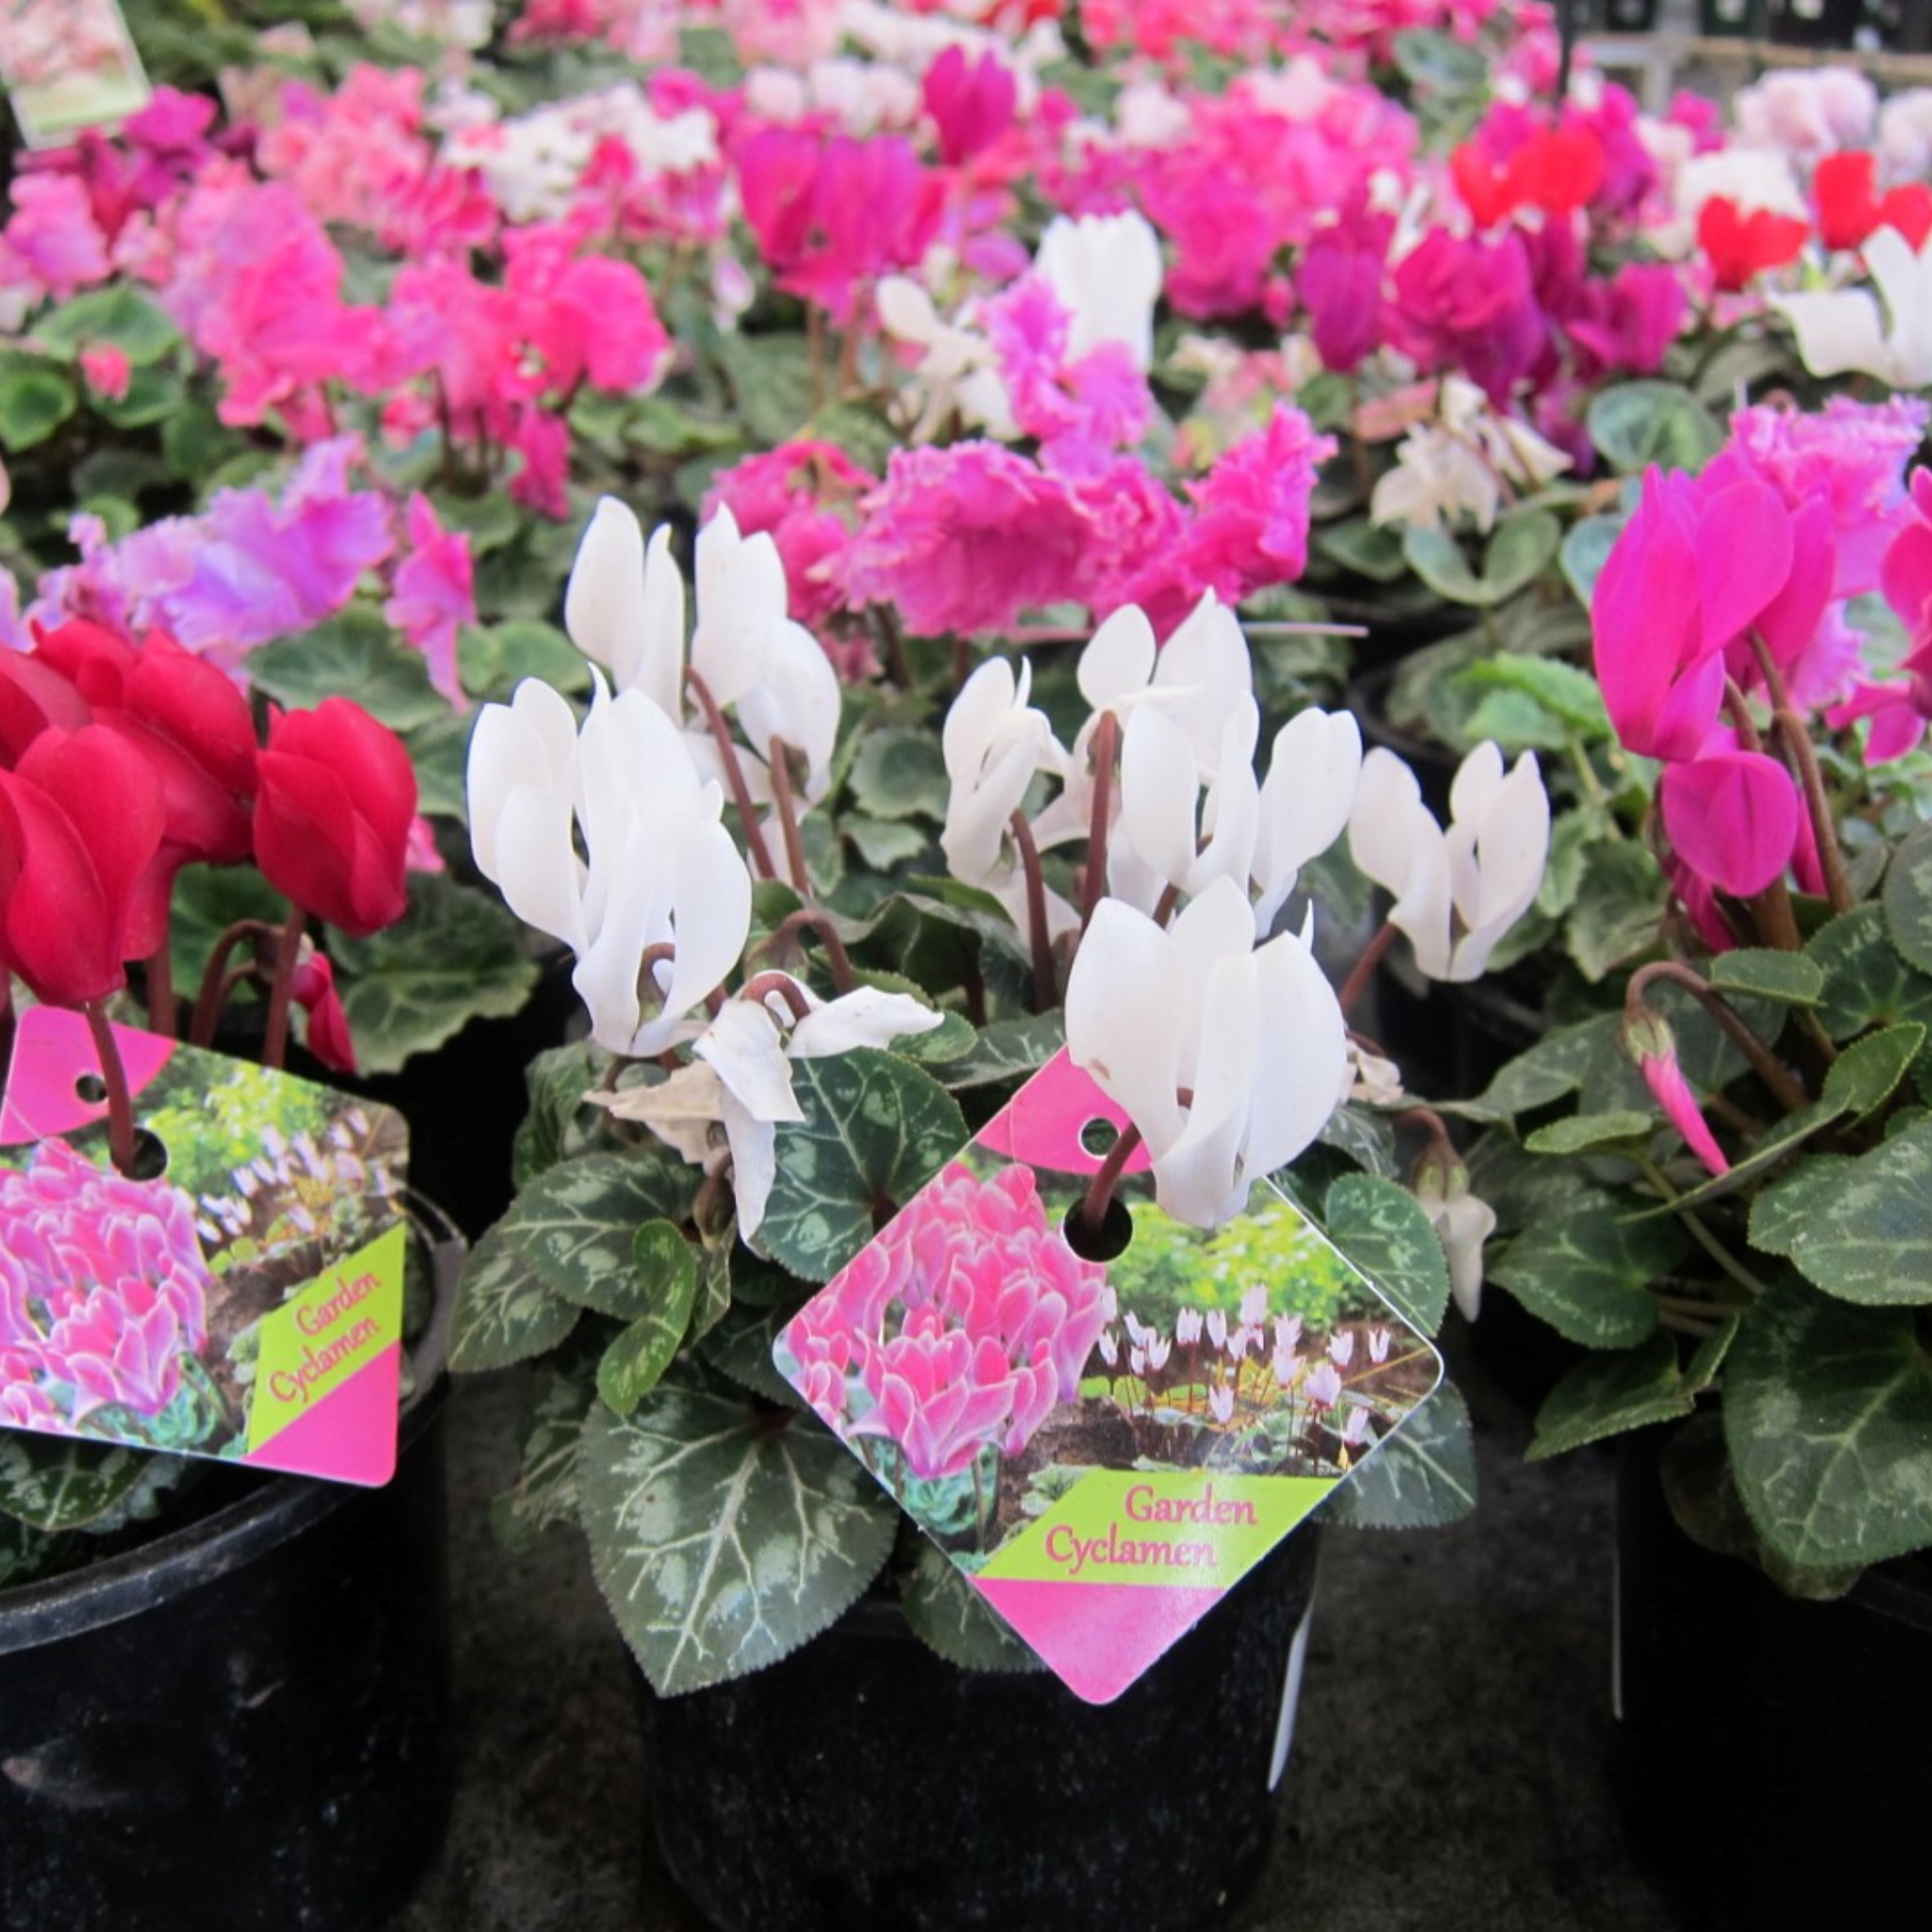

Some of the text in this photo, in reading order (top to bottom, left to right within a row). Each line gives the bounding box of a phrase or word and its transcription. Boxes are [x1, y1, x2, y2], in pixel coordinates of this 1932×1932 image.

[296, 1271, 382, 1337] Garden
[269, 1317, 381, 1404] Cyclamen
[1124, 1482, 1258, 1525] Garden
[1044, 1522, 1218, 1575] Cyclamen
